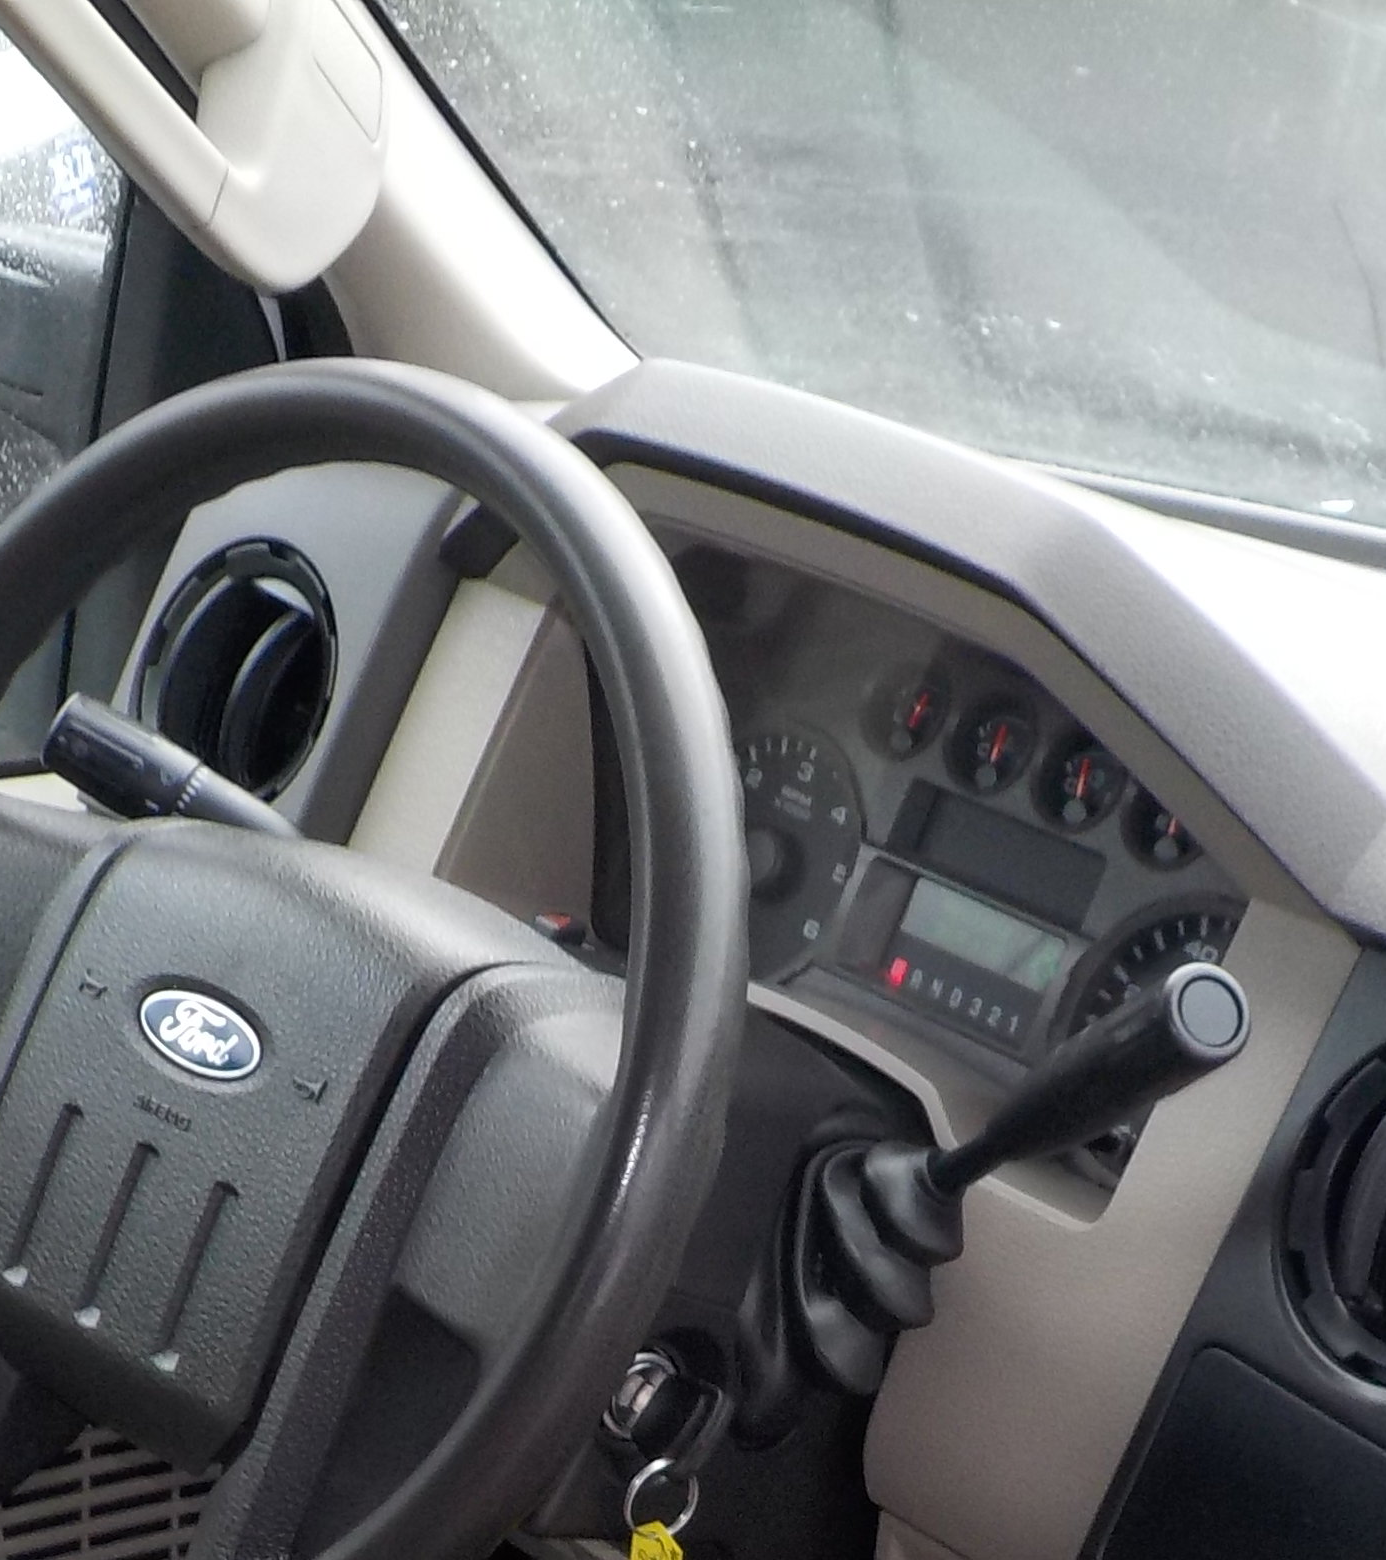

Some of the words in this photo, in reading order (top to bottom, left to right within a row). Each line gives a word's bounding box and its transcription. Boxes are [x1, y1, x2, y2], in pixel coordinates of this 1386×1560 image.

[797, 761, 814, 782] 3
[830, 805, 847, 826] 4
[802, 919, 820, 940] 6
[969, 997, 983, 1018] 3
[986, 1005, 1002, 1027] 2
[1009, 1015, 1020, 1034] 1
[159, 1000, 240, 1066] Ford
